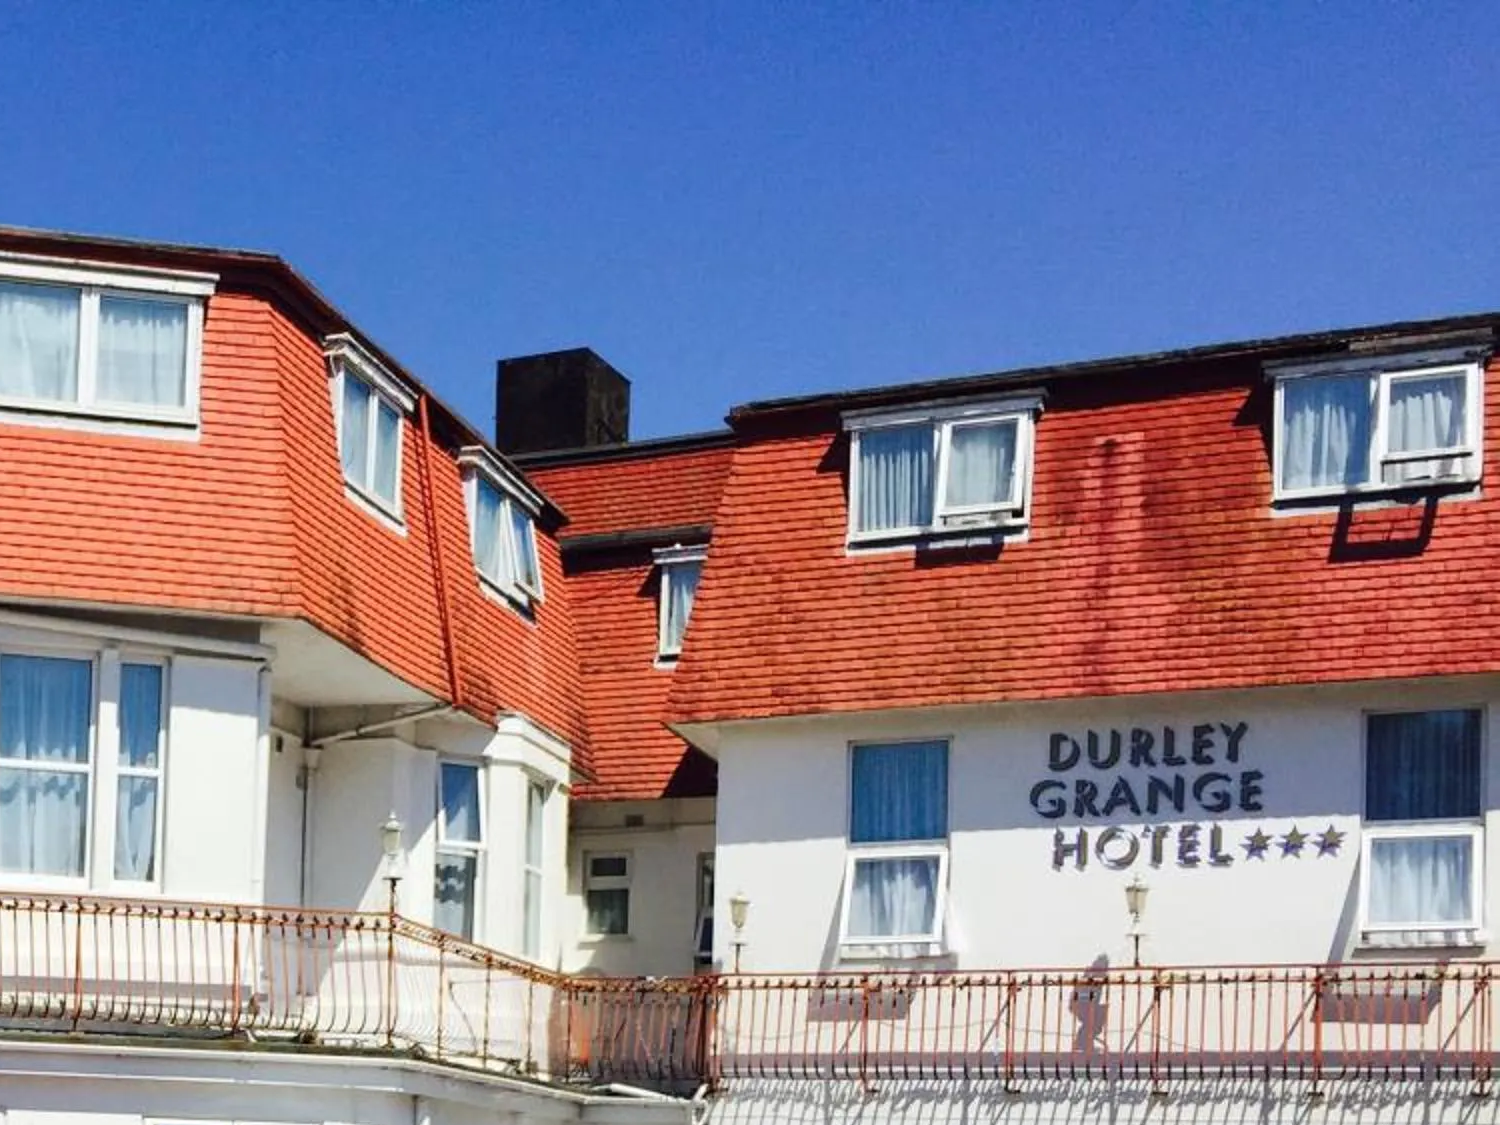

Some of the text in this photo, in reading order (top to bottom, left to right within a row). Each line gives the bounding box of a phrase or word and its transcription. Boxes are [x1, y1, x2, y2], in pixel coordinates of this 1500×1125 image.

[1048, 721, 1248, 772] DURLEY
[1029, 769, 1264, 819] GRANGE
[1052, 823, 1233, 871] HOTEL
